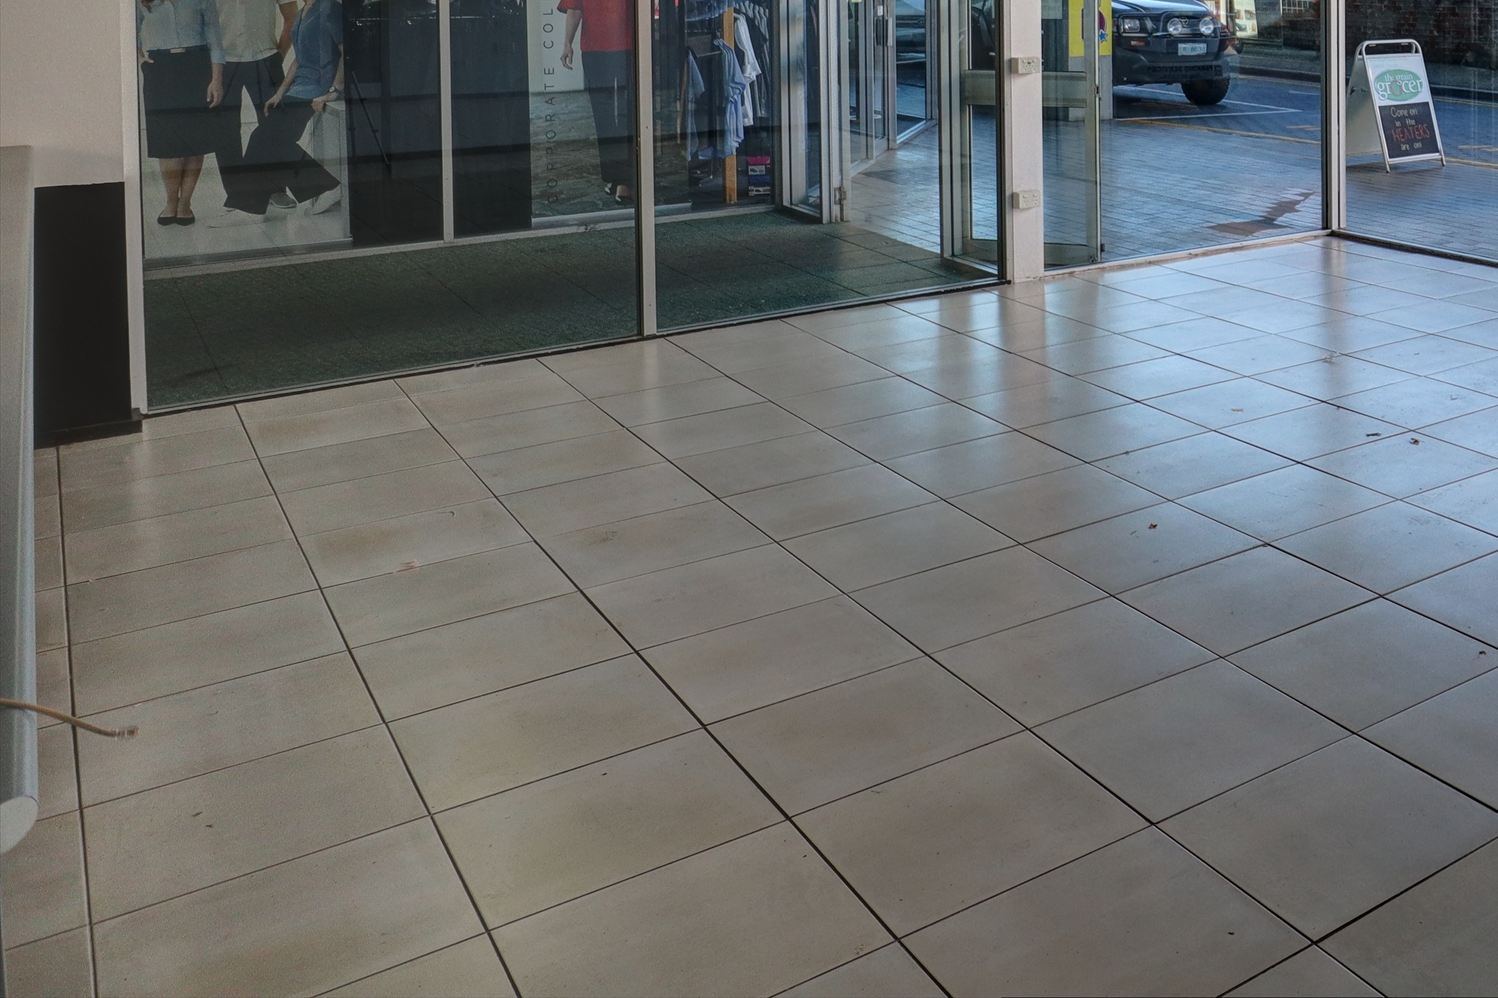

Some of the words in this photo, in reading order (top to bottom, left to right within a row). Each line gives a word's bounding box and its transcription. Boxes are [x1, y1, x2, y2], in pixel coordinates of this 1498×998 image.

[1385, 73, 1393, 82] the
[1396, 73, 1413, 84] grain
[1377, 79, 1423, 100] grocer
[1390, 107, 1408, 117] Come
[1409, 107, 1418, 116] on
[1406, 118, 1416, 126] the
[543, 67, 558, 204] CORPORATE
[1392, 124, 1430, 142] HEATERS
